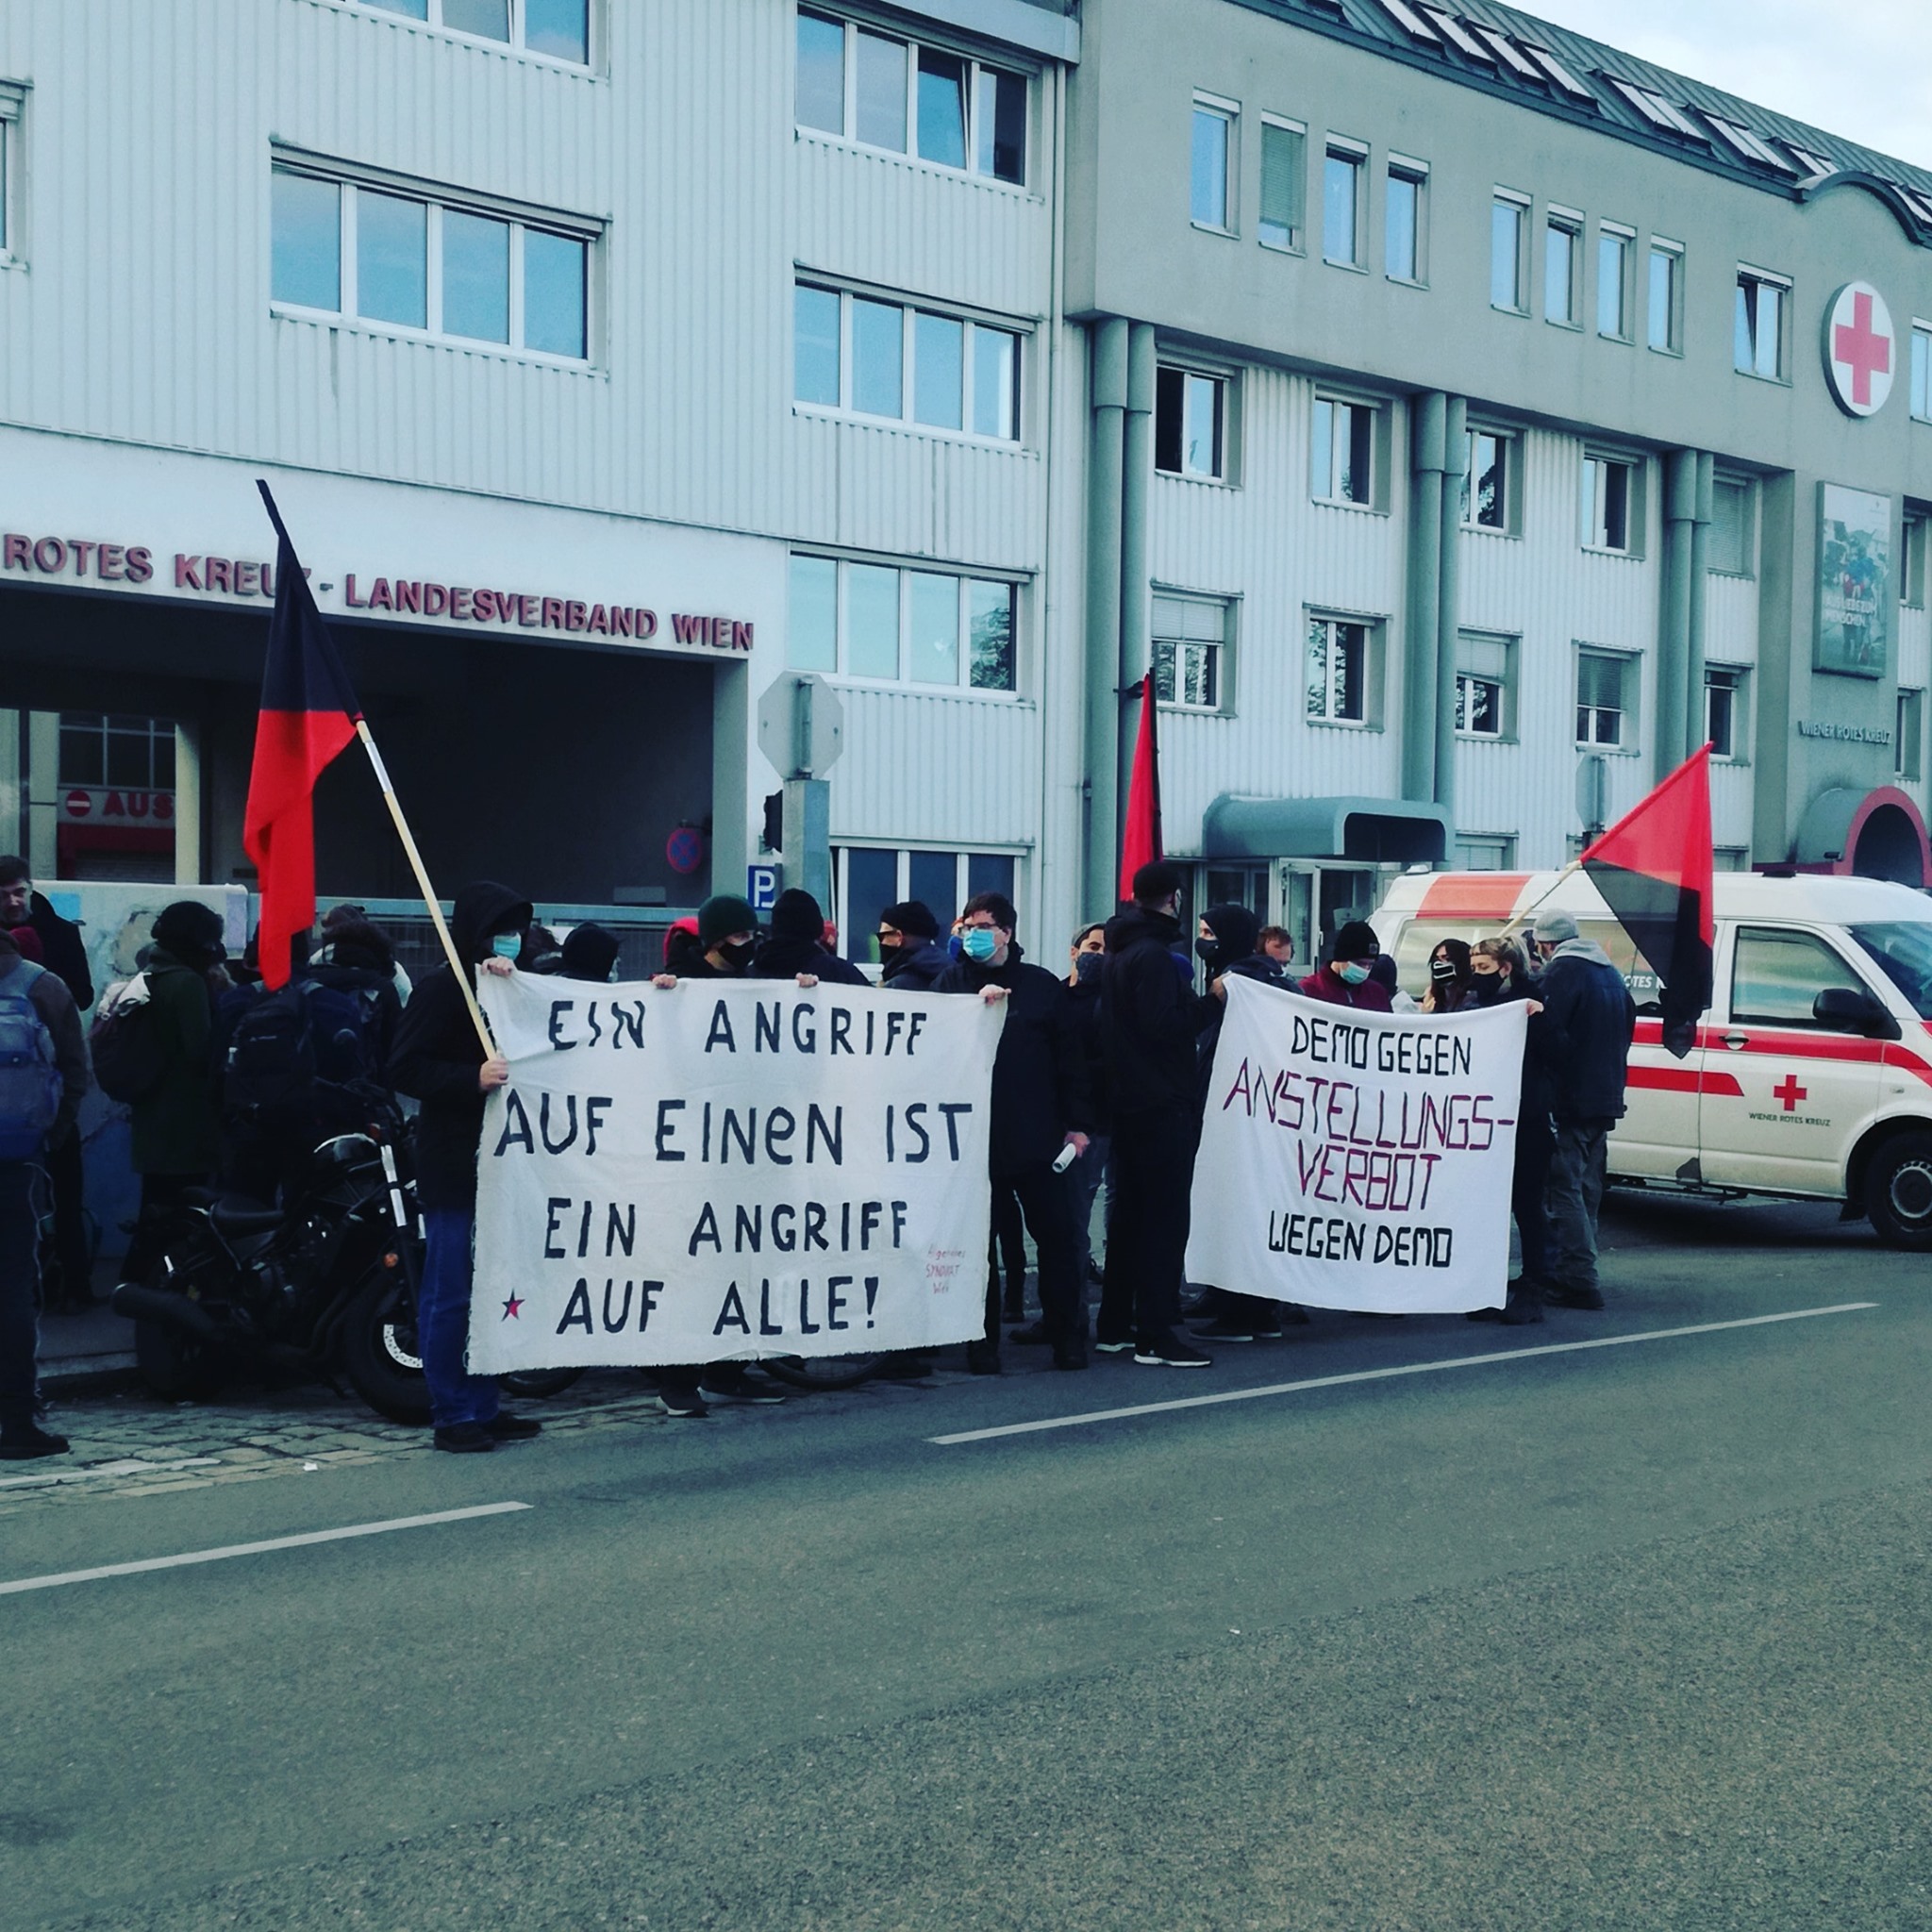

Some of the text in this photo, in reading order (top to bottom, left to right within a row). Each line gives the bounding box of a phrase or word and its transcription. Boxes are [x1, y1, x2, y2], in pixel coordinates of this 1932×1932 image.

[4, 533, 154, 583] ROTES
[345, 573, 658, 640] LANDESVERBAND
[671, 613, 754, 651] WIEN
[1797, 721, 1891, 745] WIENER ROTES KREUZ
[102, 790, 175, 820] AUS
[754, 870, 775, 908] P
[1624, 974, 1653, 989] OTES
[548, 1000, 927, 1056] EIN ANGRIFF
[1291, 1015, 1471, 1075] DEMO GEGEN
[493, 1089, 612, 1157] AUF
[886, 1103, 973, 1163] IST
[1223, 1057, 1515, 1150] ANSTELLUNGS-
[1749, 1113, 1831, 1127] WIENER ROTES KREUZ
[1298, 1139, 1442, 1211] VERBOT
[544, 1197, 908, 1259] EIN ANGRIFF
[1268, 1210, 1453, 1268] WEGEN DEMO
[556, 1276, 879, 1336] AUF ALLE!
